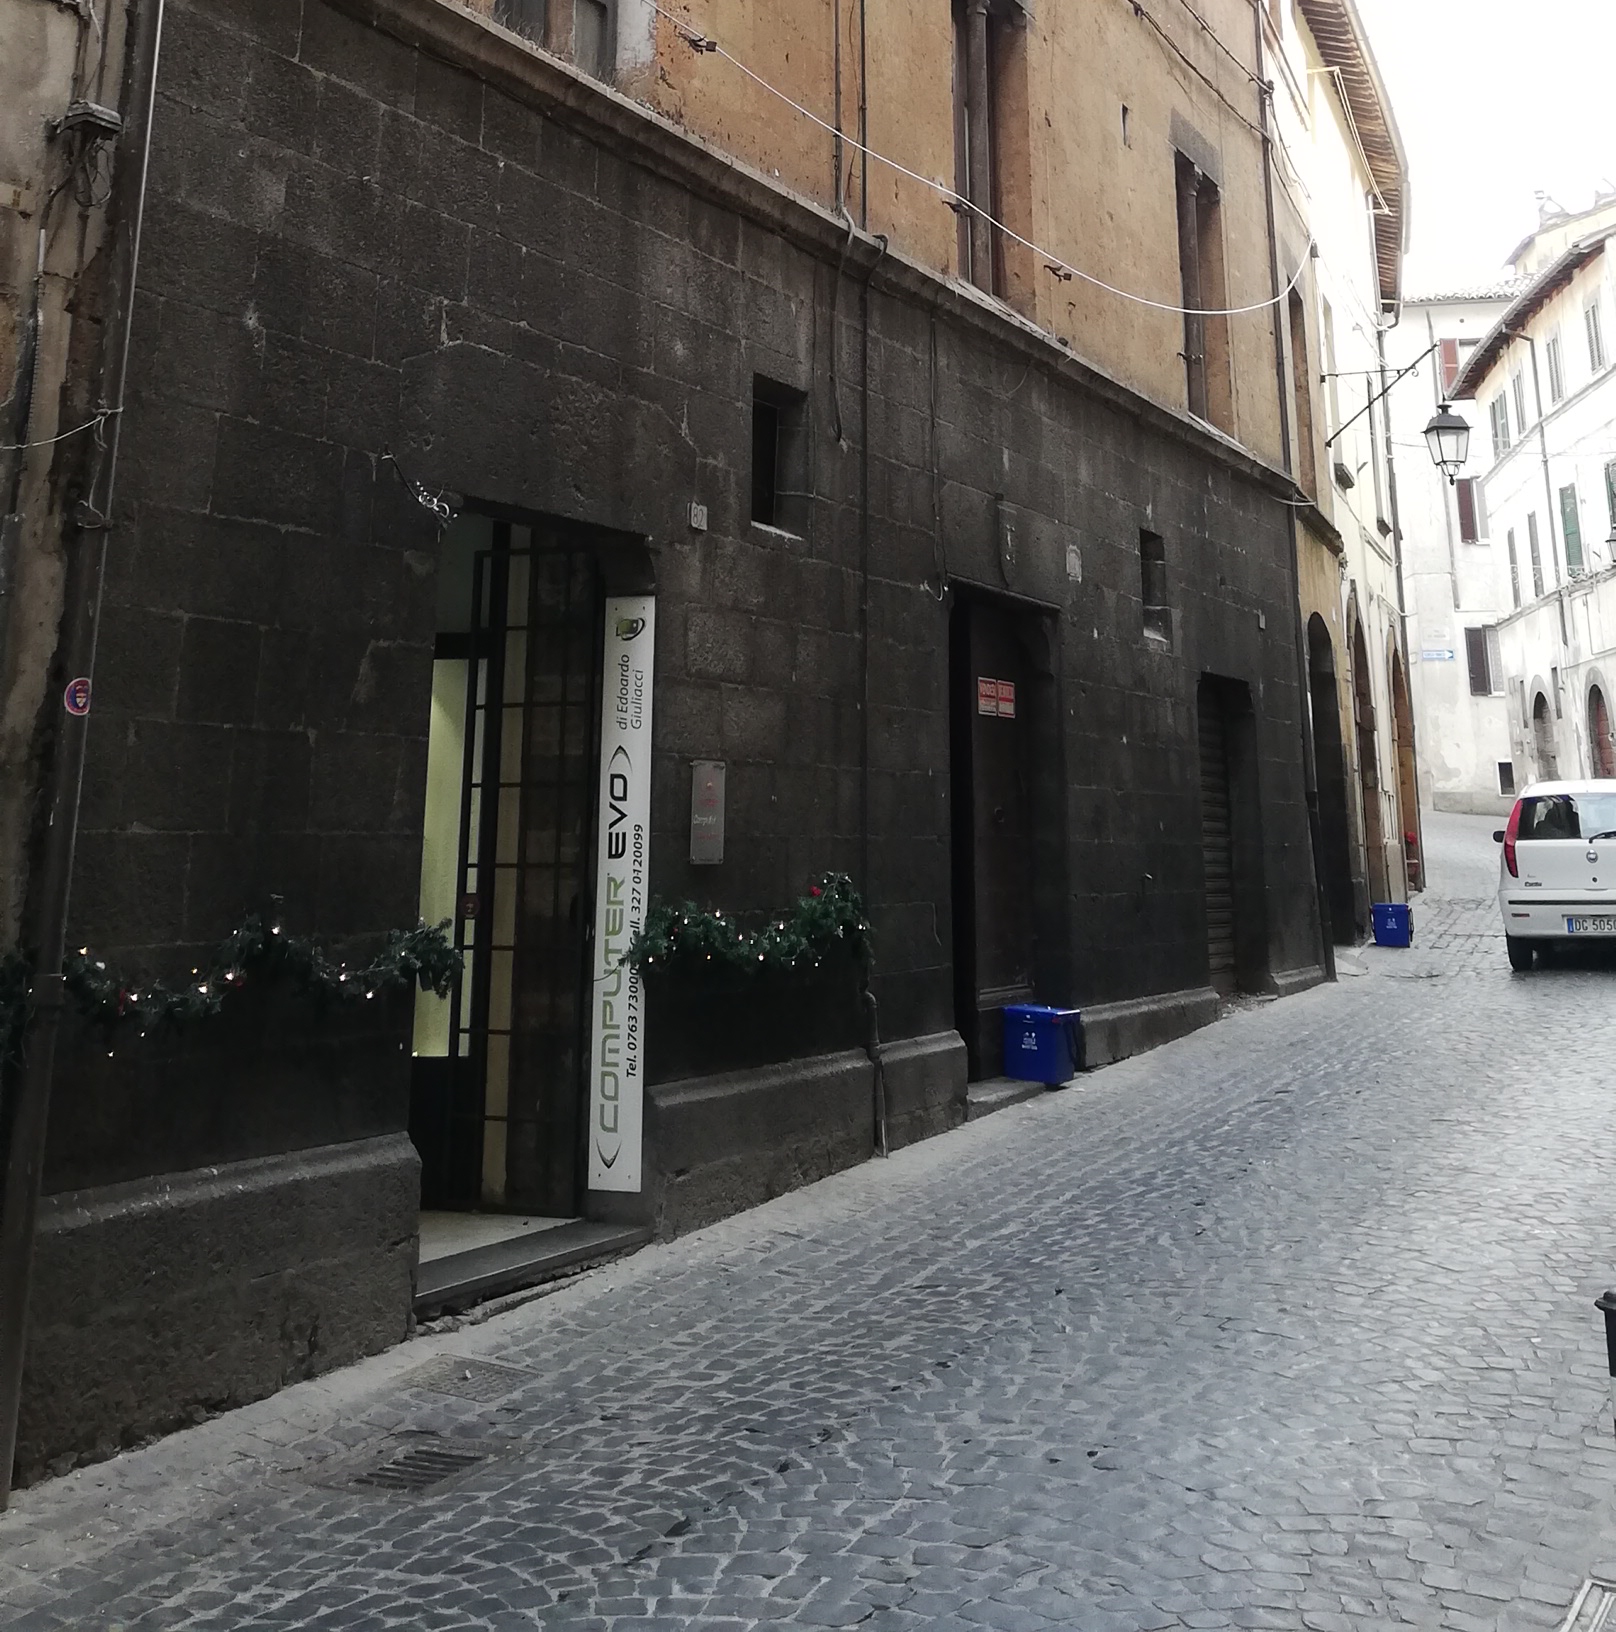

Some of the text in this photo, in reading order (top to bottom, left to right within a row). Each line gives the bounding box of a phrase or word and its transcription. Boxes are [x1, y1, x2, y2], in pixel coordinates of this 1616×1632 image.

[692, 506, 704, 528] 82
[616, 654, 630, 730] di Edoardo
[631, 669, 644, 730] Giuliacci
[631, 888, 642, 914] 327
[1575, 919, 1588, 931] DG
[599, 773, 628, 1134] COMPUTER EVO
[627, 1015, 638, 1051] 0763
[626, 1055, 637, 1078] Tel.
